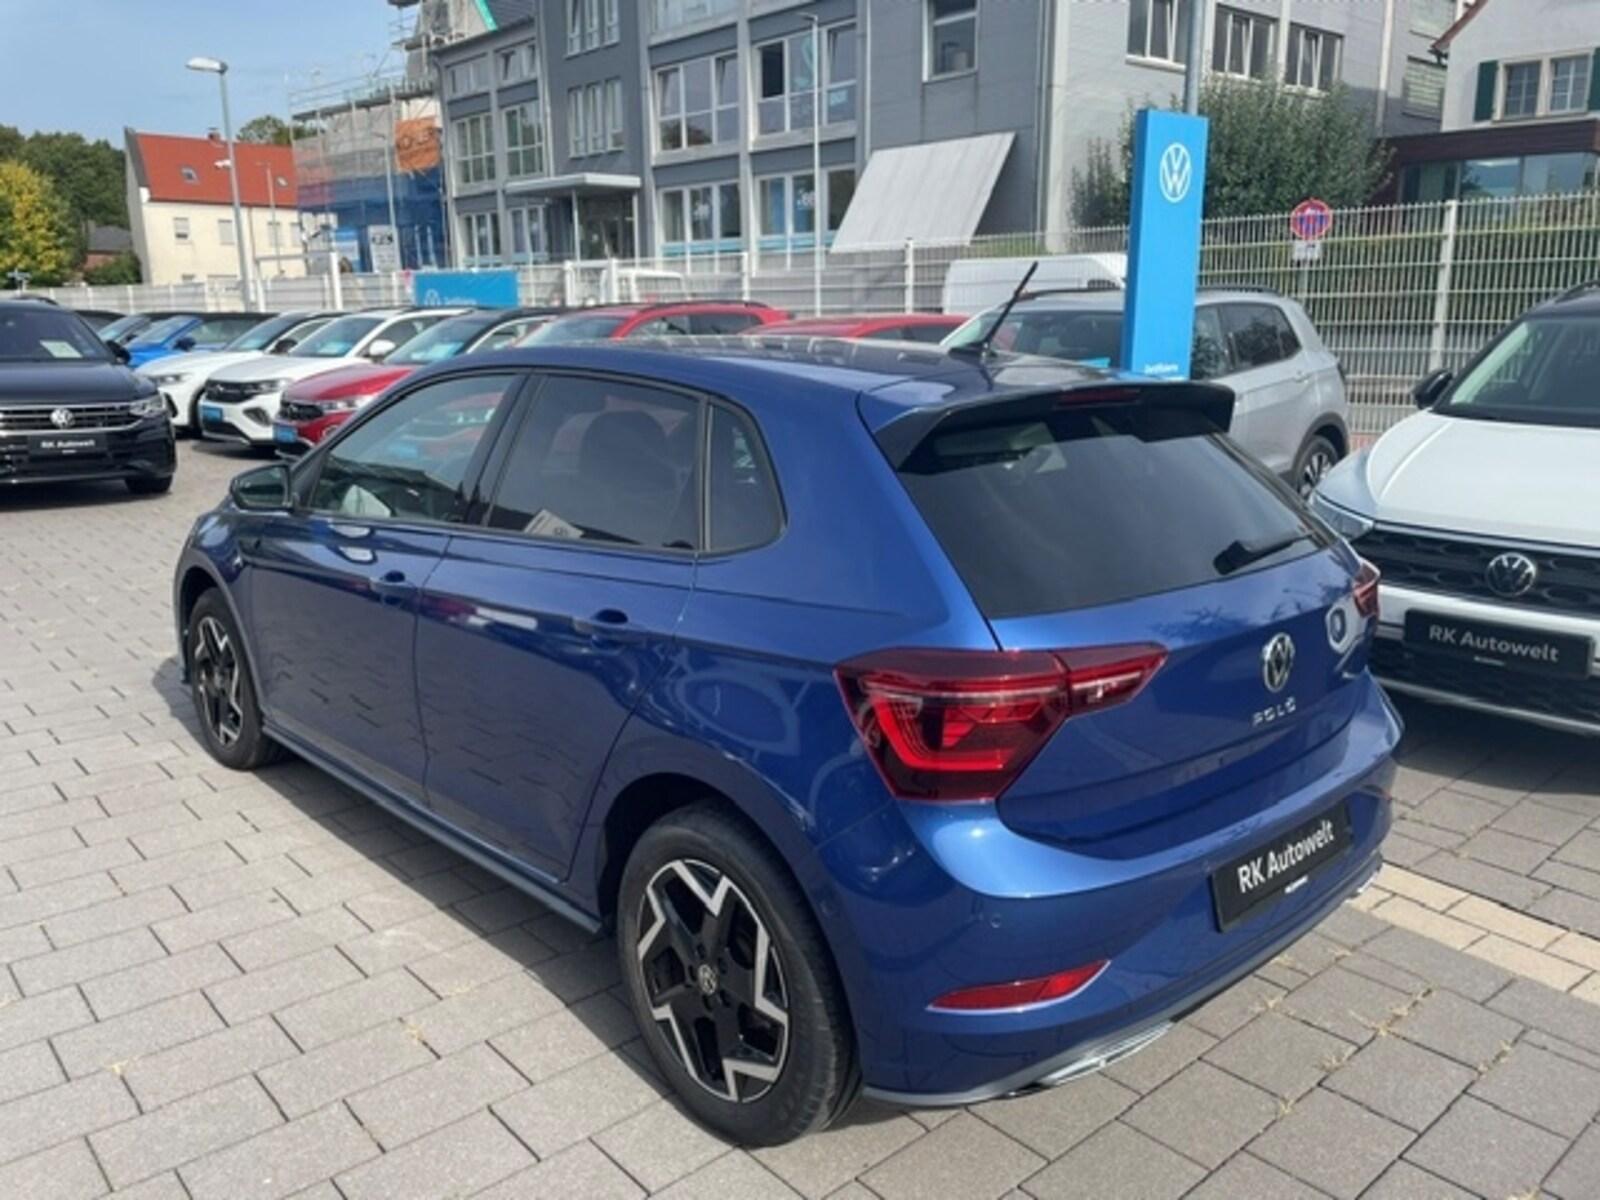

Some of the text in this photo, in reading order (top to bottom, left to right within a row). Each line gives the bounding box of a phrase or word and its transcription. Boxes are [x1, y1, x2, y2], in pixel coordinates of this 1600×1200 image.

[1429, 624, 1456, 644] RK
[1460, 631, 1559, 663] Autowelt
[1252, 696, 1296, 727] POLO
[1237, 857, 1265, 893] RK
[1267, 820, 1334, 878] Autowelt
